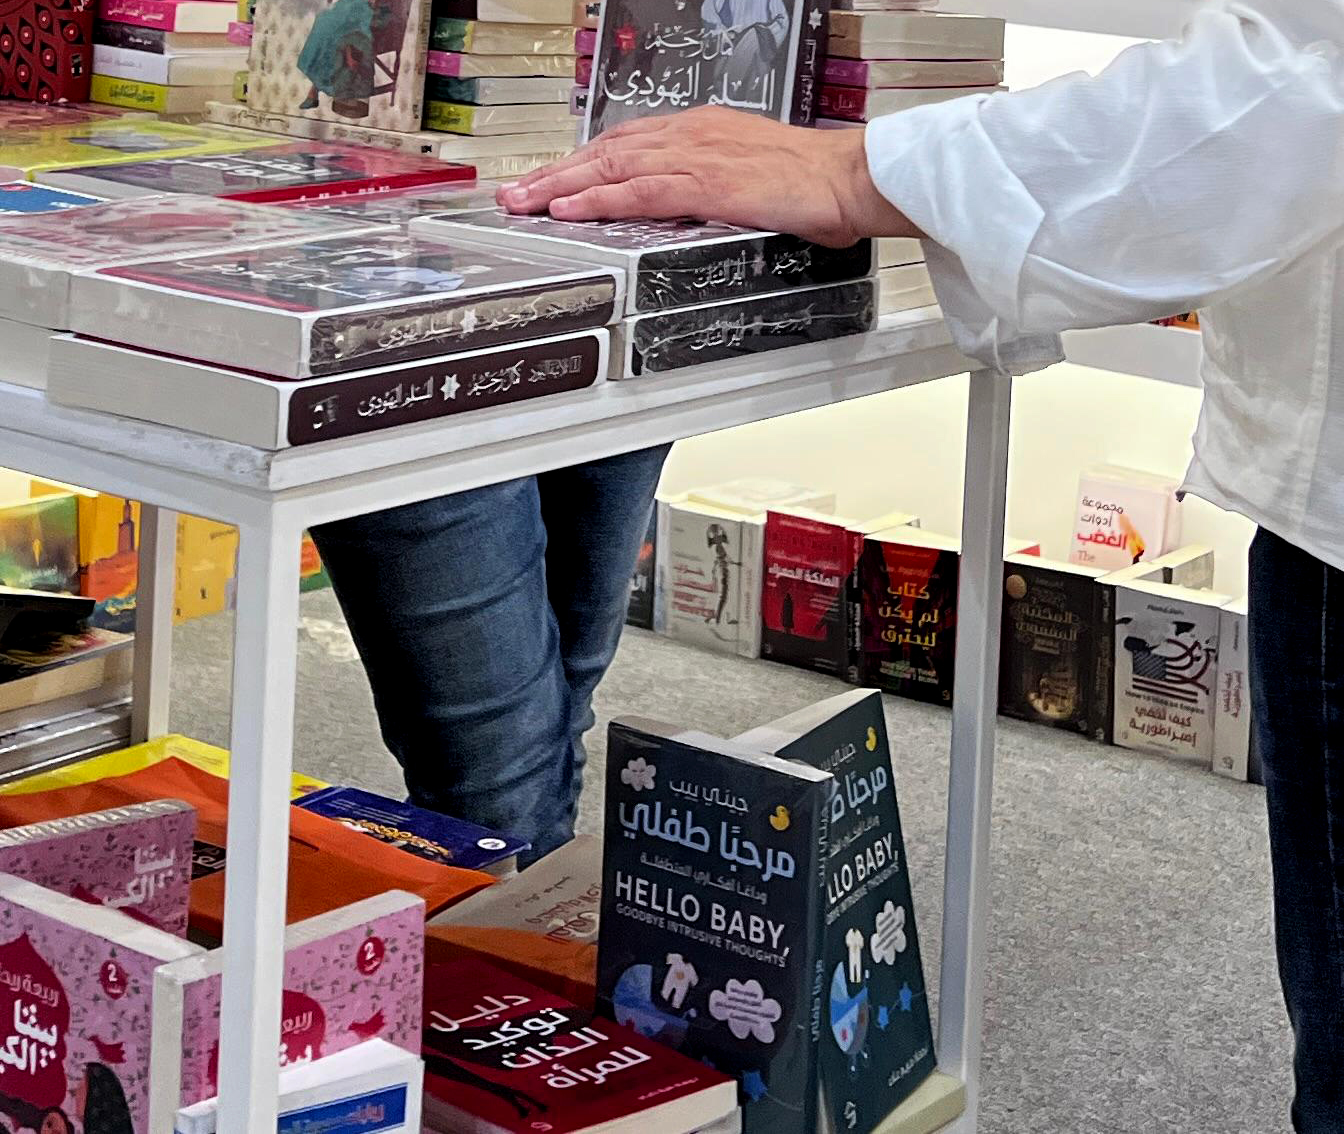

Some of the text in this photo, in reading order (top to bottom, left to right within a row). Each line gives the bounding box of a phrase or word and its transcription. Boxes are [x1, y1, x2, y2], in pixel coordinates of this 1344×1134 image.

[1077, 530, 1129, 550] الغضب
[1078, 550, 1096, 562] The
[887, 582, 930, 599] كتاب
[878, 604, 938, 625] لم يكن
[881, 627, 937, 649] ليحترق
[1168, 713, 1192, 727] كيف
[619, 801, 795, 881] مرحبًا طفلي
[615, 871, 790, 957] HELLO BABY,
[615, 903, 786, 968] GOODBYE INTRUSIVE THOUGHTS
[364, 944, 375, 961] 2
[107, 966, 118, 982] 2
[429, 993, 531, 1032] دليل
[461, 1008, 569, 1053] توكيد
[501, 1027, 609, 1070] الذات
[539, 1046, 652, 1090] للمرأة
